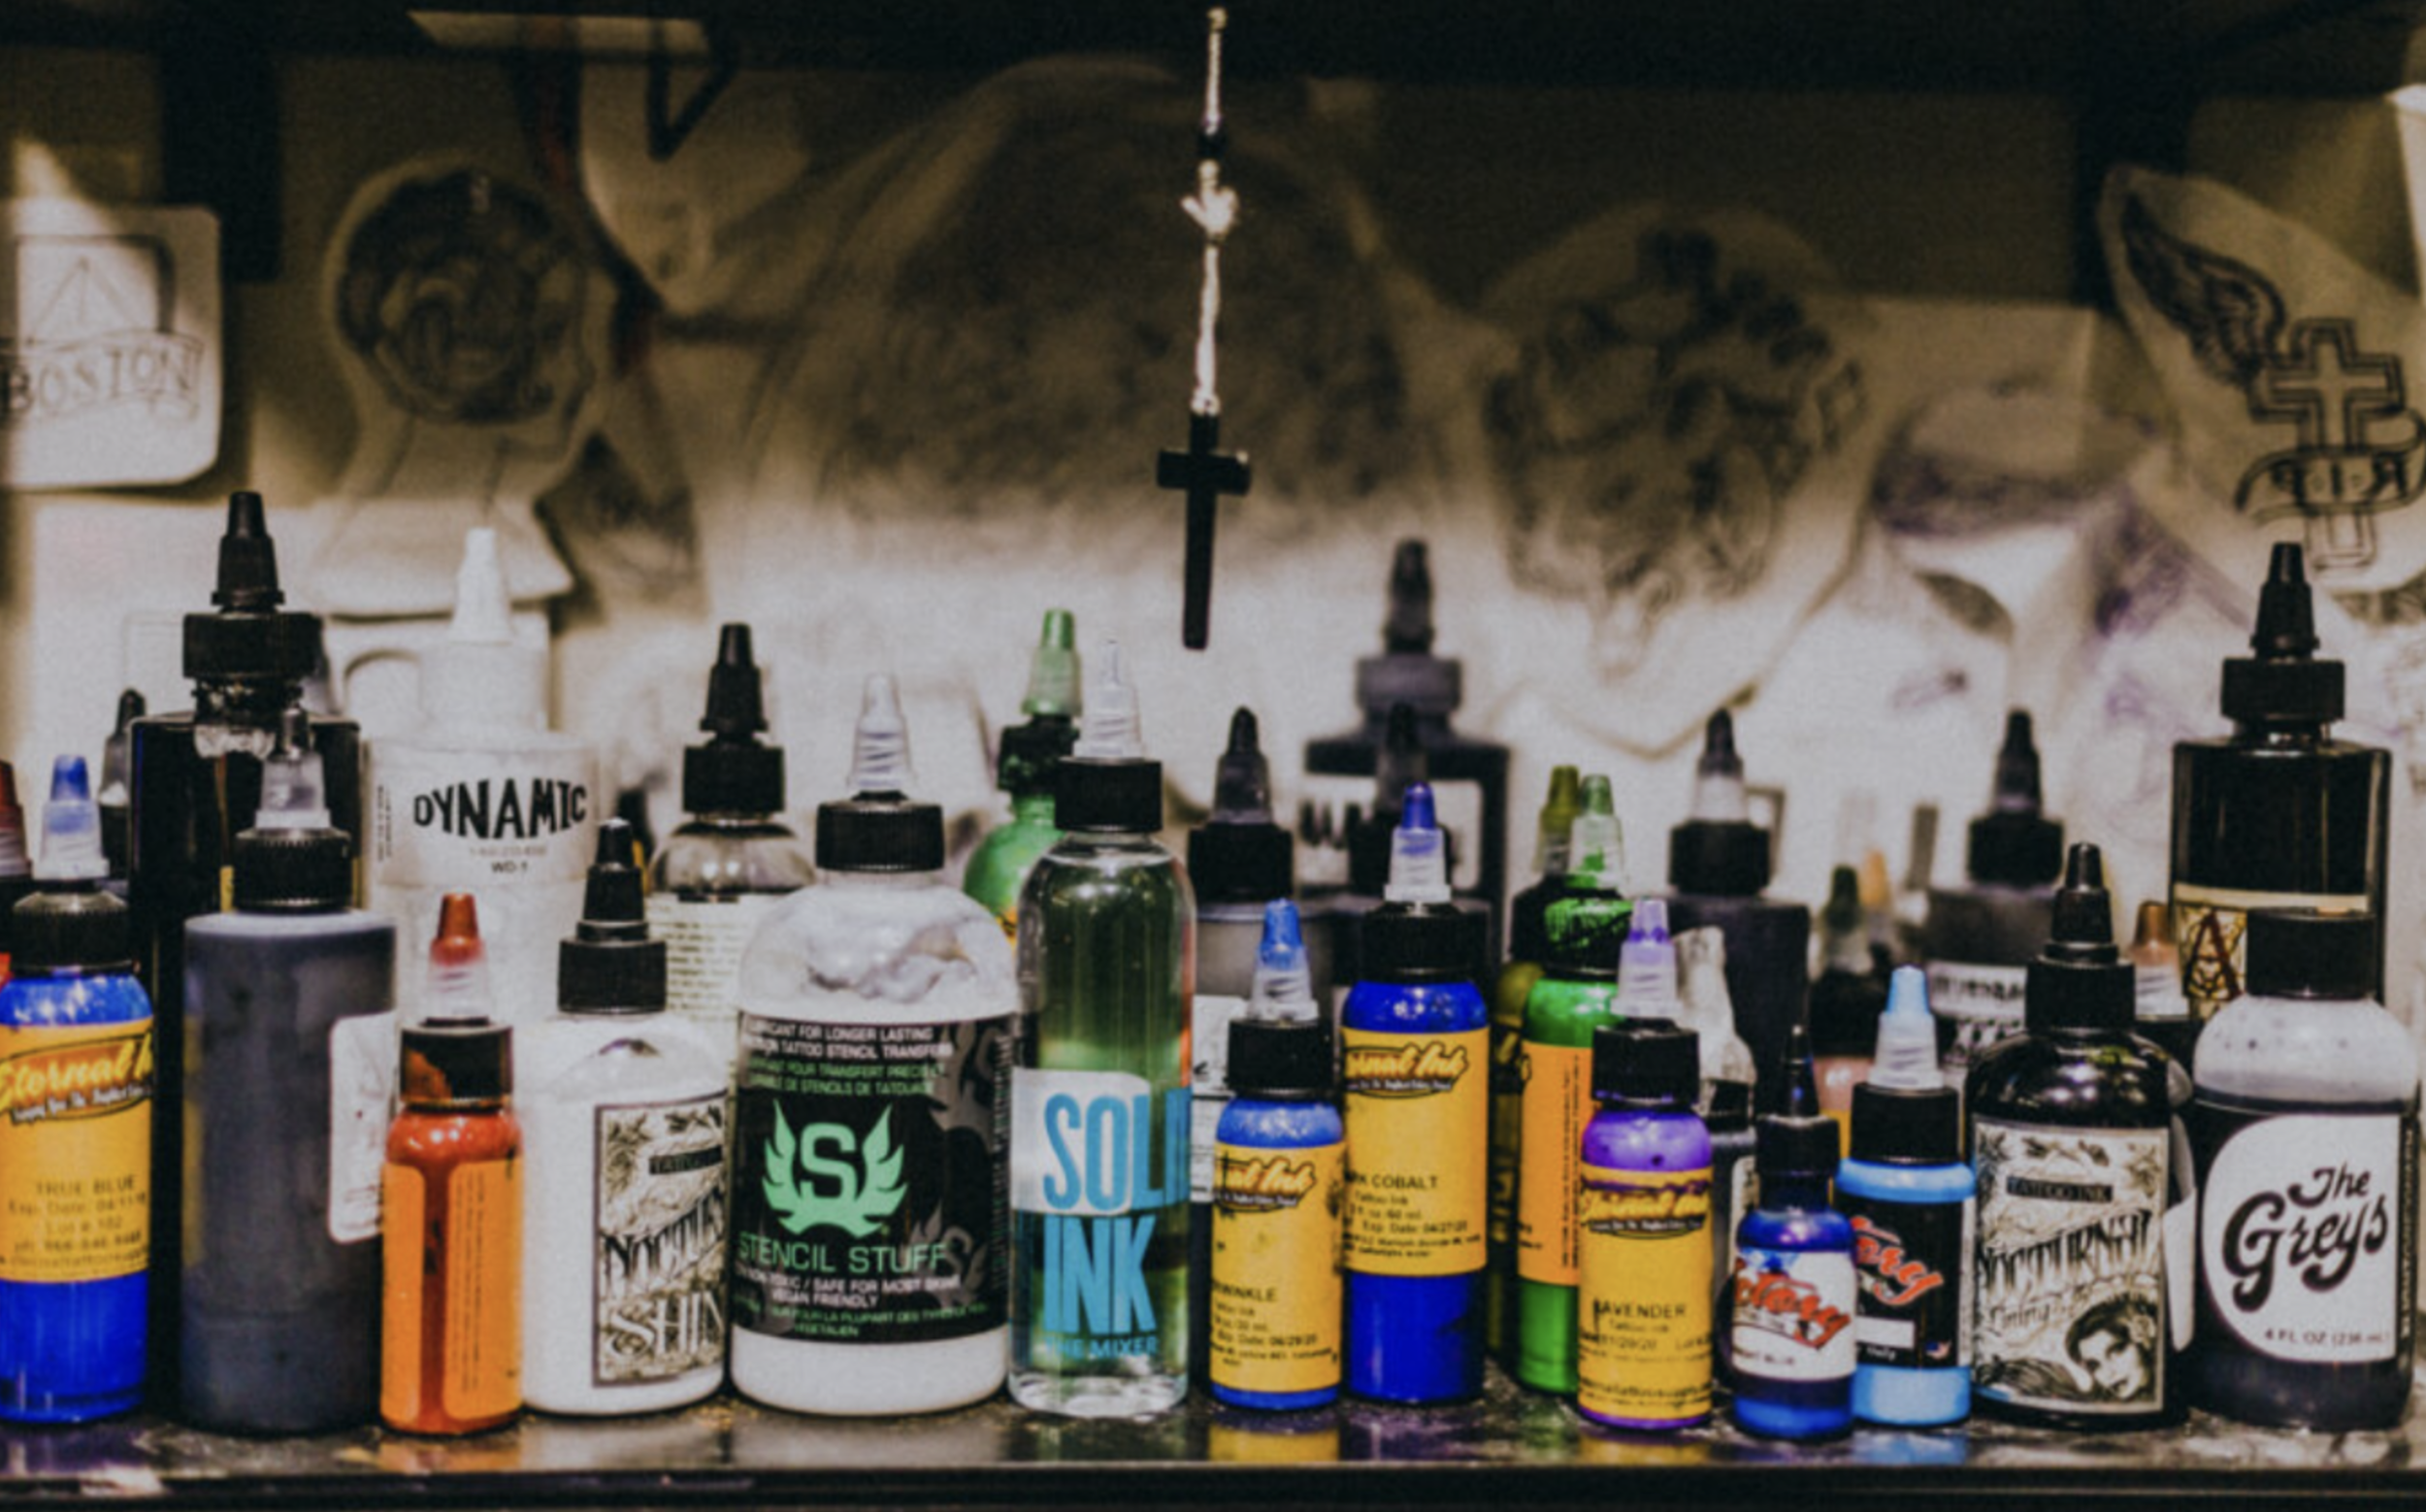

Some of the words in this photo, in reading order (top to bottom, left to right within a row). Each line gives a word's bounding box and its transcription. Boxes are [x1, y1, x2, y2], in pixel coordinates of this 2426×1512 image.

[414, 777, 587, 840] DYNAMIC
[799, 1024, 822, 1039] FOR
[826, 1026, 876, 1041] LONGER
[880, 1027, 933, 1041] LASTING
[782, 1040, 822, 1056] TATTOO
[827, 1043, 877, 1059] STENCIL
[1371, 1174, 1437, 1190] COBALT
[2007, 1176, 2073, 1200] TATTOO
[2078, 1185, 2108, 1201] INK
[2287, 1161, 2370, 1209] The
[738, 1231, 836, 1272] STENCIL
[848, 1243, 947, 1273] STUFF
[813, 1277, 845, 1293] SAFE
[850, 1278, 877, 1293] FOR
[882, 1276, 921, 1293] MOST
[1043, 1213, 1158, 1335] INK
[771, 1289, 810, 1305] VEGAN
[813, 1292, 879, 1308] FRIENDLY
[609, 1291, 725, 1360] SHIN
[1044, 1336, 1084, 1359] THE
[1088, 1335, 1159, 1359] MIXER
[2278, 1331, 2298, 1344] FL
[2304, 1331, 2327, 1345] OZ
